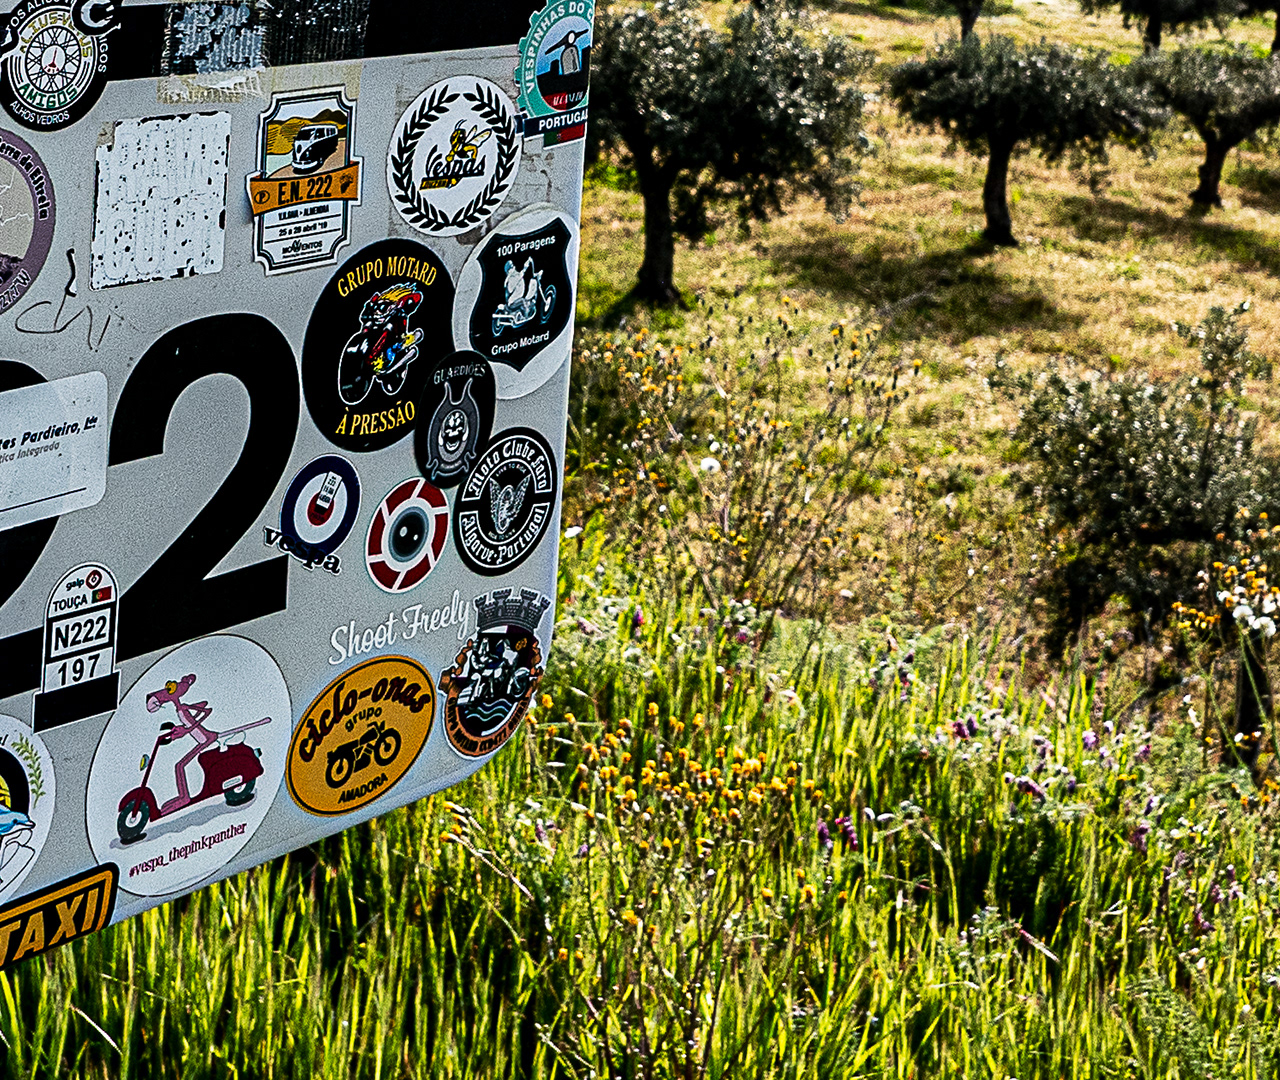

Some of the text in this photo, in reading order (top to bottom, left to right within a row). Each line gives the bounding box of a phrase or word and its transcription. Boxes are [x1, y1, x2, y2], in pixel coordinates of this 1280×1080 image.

[525, 1, 586, 94] VESPINHAS DO
[277, 174, 333, 206] E.N. 222
[496, 234, 557, 258] 100 Paragens
[337, 255, 438, 298] GRUPO MOTARD
[491, 329, 551, 357] Grupo Motard
[350, 399, 417, 437] PRESSÃO
[16, 441, 61, 461] Integrada
[52, 590, 88, 612] TOUÇA
[53, 614, 108, 653] N222
[327, 588, 472, 667] Shoot Freely
[57, 652, 102, 687] 197
[297, 672, 433, 765] ciclo-onas
[343, 704, 384, 734] grupo
[336, 773, 389, 805] AMADORA
[127, 821, 248, 879] #vespa_thepinkpanther
